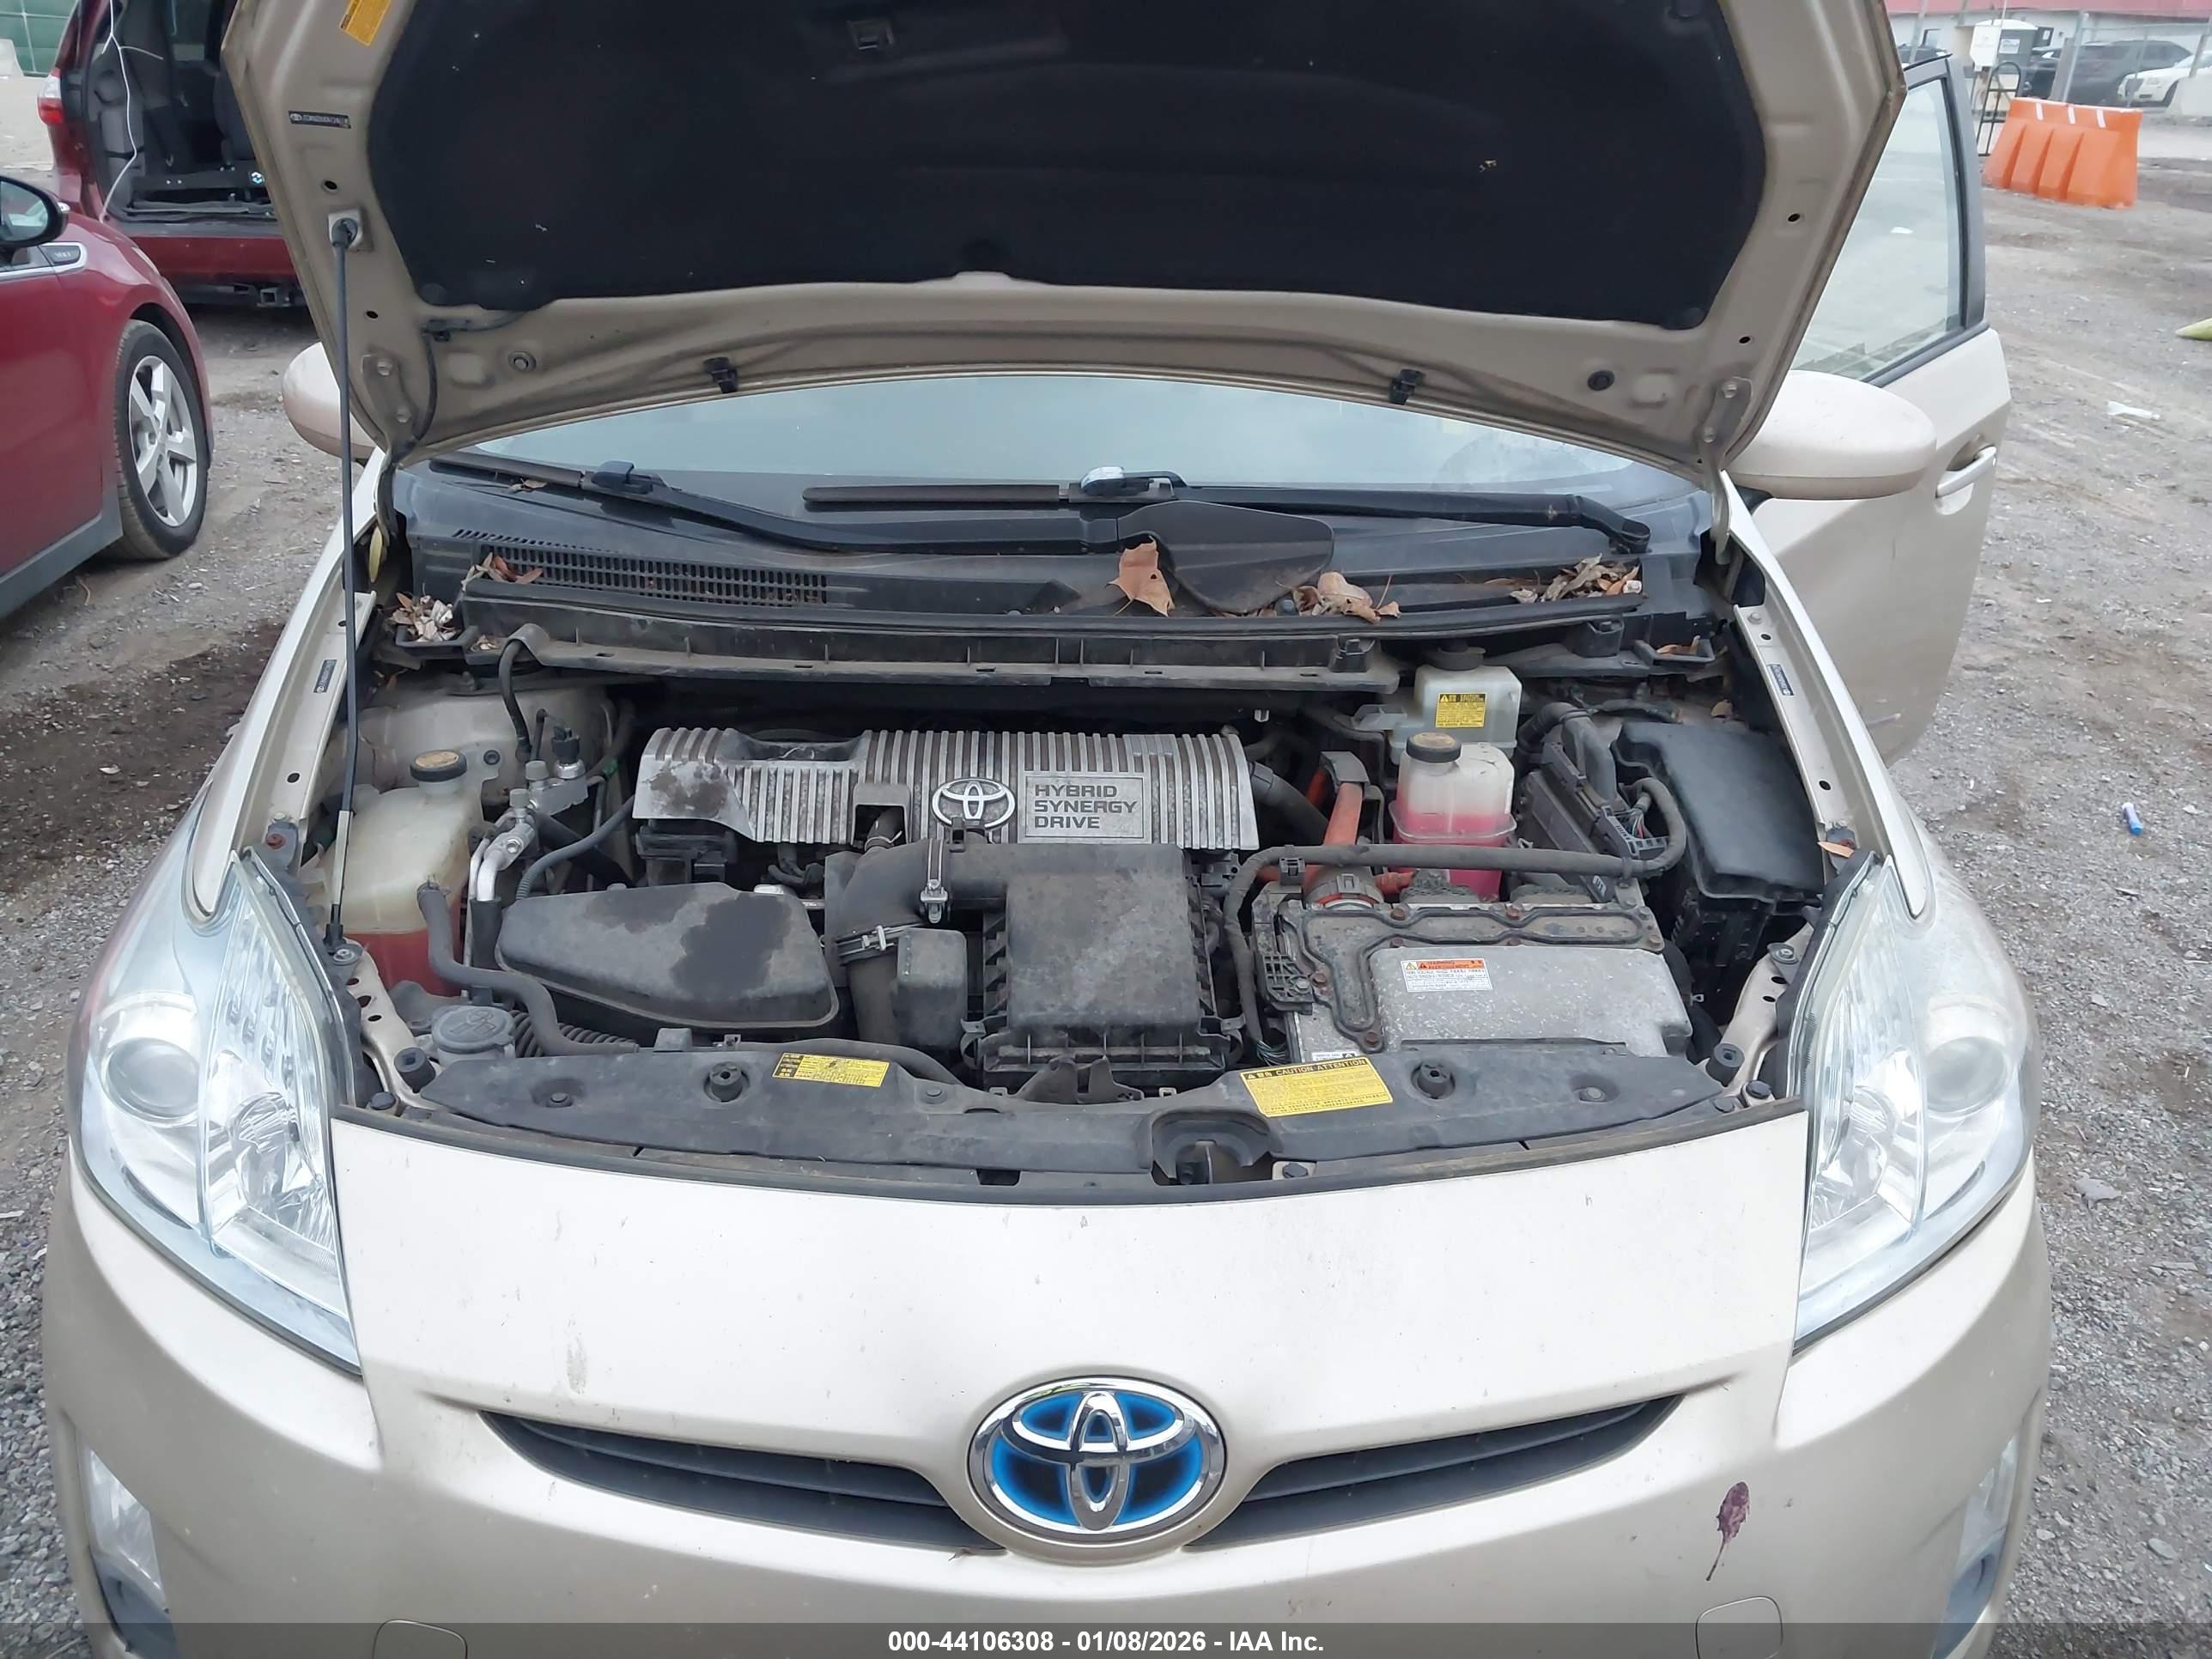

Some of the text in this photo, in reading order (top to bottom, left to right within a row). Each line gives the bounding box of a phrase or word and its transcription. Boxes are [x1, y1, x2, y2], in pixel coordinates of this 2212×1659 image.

[1035, 785, 1117, 797] HYBRID
[1035, 800, 1137, 813] SYNERGY
[1035, 816, 1100, 829] DRIVE
[1275, 1066, 1314, 1076] CAUTION
[1317, 1060, 1366, 1071] ATTENTION
